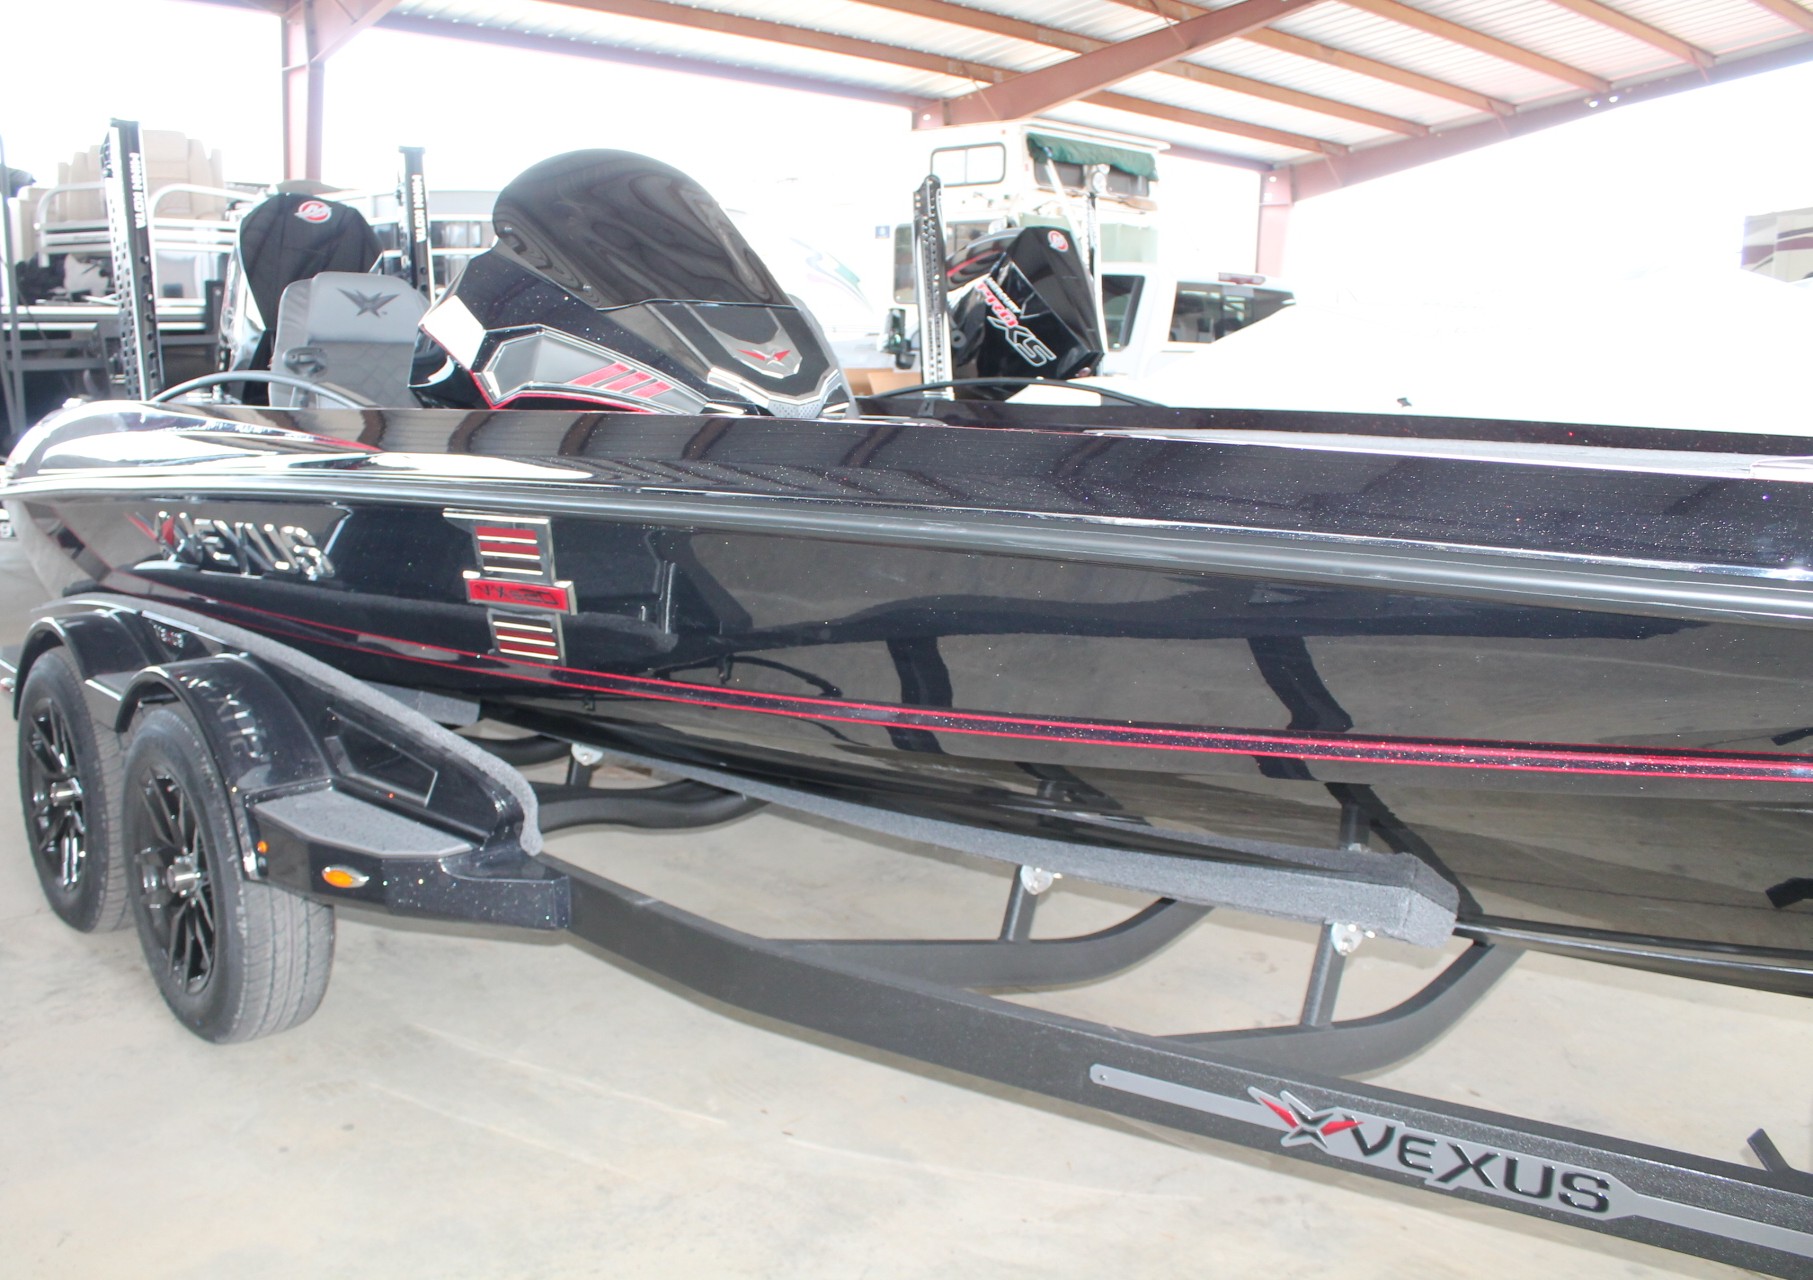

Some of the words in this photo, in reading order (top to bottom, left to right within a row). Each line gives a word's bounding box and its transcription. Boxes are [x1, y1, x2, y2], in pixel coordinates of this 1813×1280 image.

[129, 152, 143, 190] MINN
[133, 191, 148, 229] KOTA
[412, 174, 424, 208] MINN
[414, 209, 427, 243] KOTA
[986, 315, 1058, 367] XS
[156, 510, 336, 580] VEXUS
[1342, 1113, 1611, 1214] VEXUS
